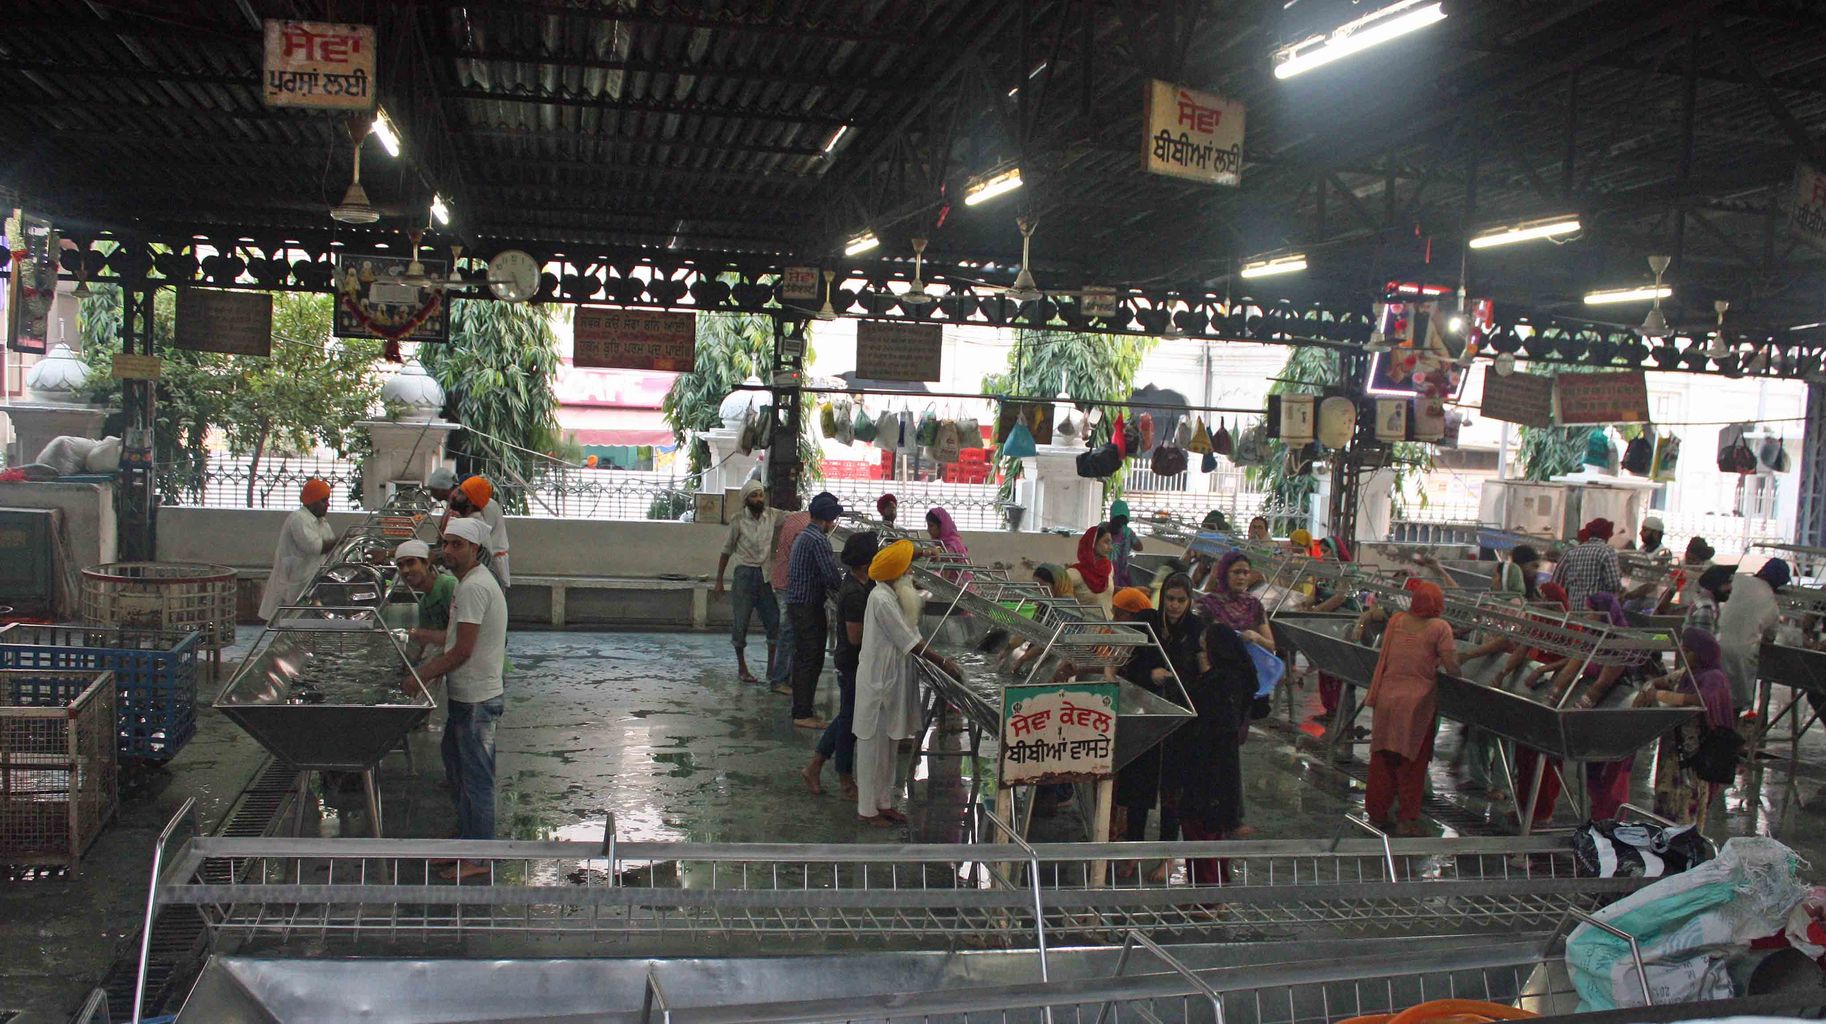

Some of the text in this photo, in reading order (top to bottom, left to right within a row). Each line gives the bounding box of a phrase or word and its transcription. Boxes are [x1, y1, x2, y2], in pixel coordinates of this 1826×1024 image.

[282, 23, 362, 63] ਸੇਵਾ
[323, 68, 368, 97] ਲਈ
[1177, 90, 1222, 134] ਸੇਵਾ
[1153, 128, 1240, 175] ਬੀਬੀਆਂ ਲਈ
[1010, 701, 1112, 737] ਸੇਵਾ ਕੇਵਲ
[1007, 734, 1111, 764] ਬੀਬੀਆਂ ਵਾਸਤੇ
